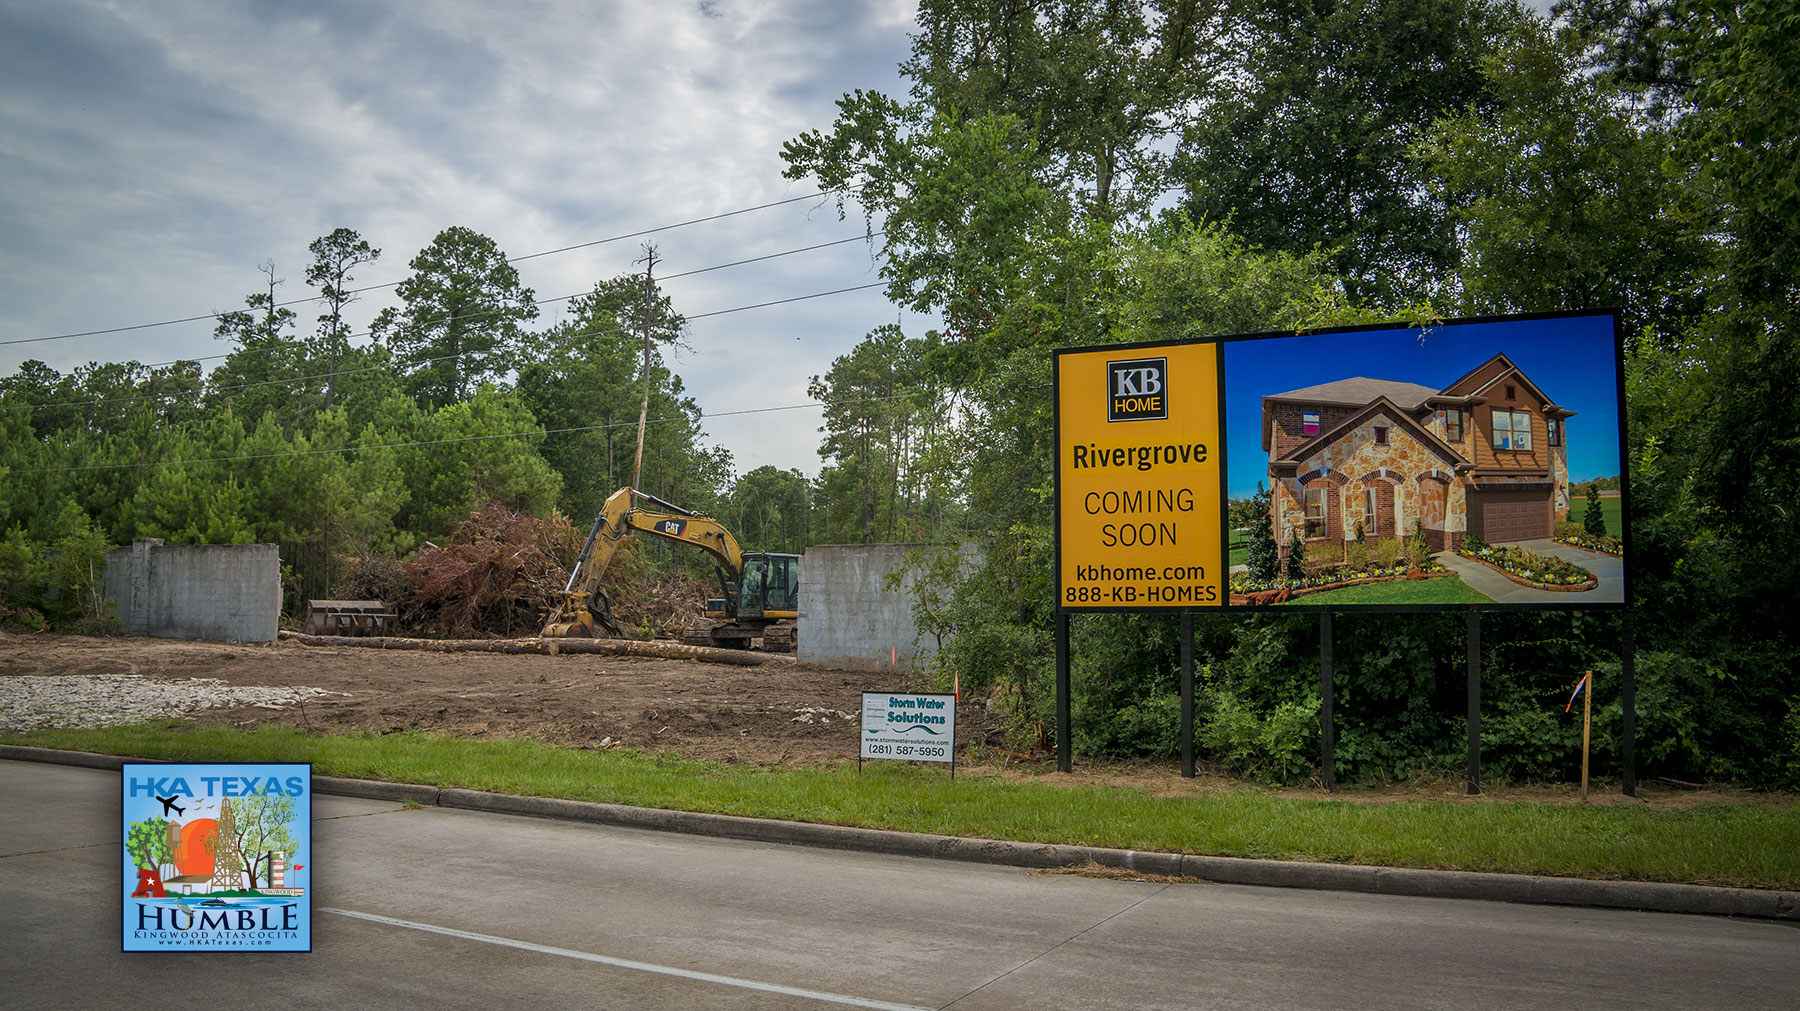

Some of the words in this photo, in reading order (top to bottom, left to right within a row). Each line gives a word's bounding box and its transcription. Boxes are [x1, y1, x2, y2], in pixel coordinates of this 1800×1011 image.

[1114, 367, 1161, 397] KB
[1114, 397, 1161, 413] HOME
[1073, 443, 1208, 471] Rivergrove
[1084, 488, 1195, 515] COMING
[665, 521, 680, 535] CAT
[1102, 522, 1177, 547] SOON
[1076, 564, 1206, 582] kbhome.com
[1065, 585, 1217, 602] 888-KB-HOMES
[889, 696, 915, 709] Storm
[916, 697, 945, 710] Water
[887, 711, 946, 725] Solutions
[865, 737, 950, 746] www.stormwatersolutions.com
[868, 744, 892, 755] (281)
[895, 745, 945, 757] 587-5950
